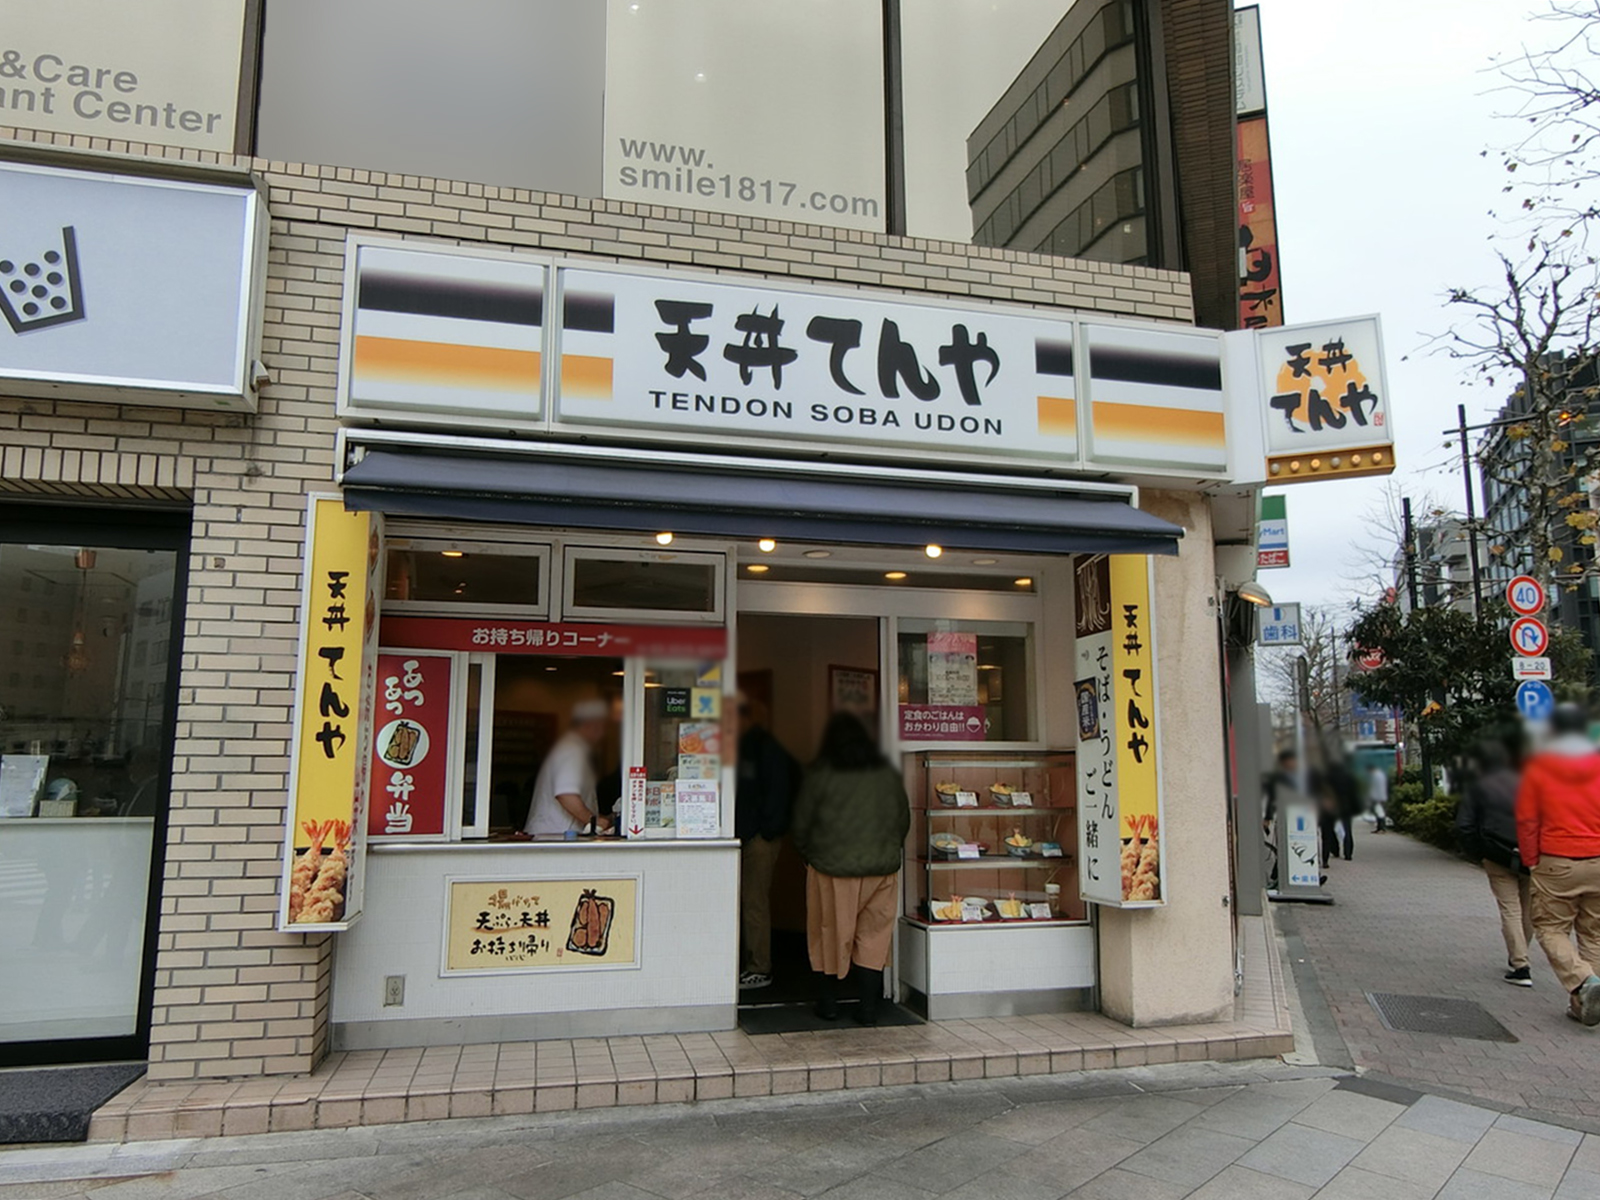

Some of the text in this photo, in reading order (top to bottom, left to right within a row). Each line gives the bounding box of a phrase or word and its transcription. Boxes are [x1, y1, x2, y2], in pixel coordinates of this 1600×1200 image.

[73, 90, 222, 134] Center
[619, 137, 714, 168] www.
[619, 166, 879, 217] smile1817.com
[654, 299, 1001, 406] 天丼てんや
[1285, 336, 1353, 378] 天丼
[649, 390, 1003, 436] TENDON SOBA UDON
[1270, 381, 1379, 433] てんや
[1516, 587, 1536, 604] 40
[472, 628, 630, 648] お持ち帰りコーナー
[1263, 624, 1298, 641] 歯科
[384, 676, 404, 715] あつ
[403, 660, 424, 706] あつ
[667, 697, 686, 705] Uber
[904, 710, 965, 720] 定食のごはんは
[1096, 646, 1115, 820] そば・うどん
[384, 771, 415, 833] 弁当
[1085, 767, 1100, 881] ご一緒に
